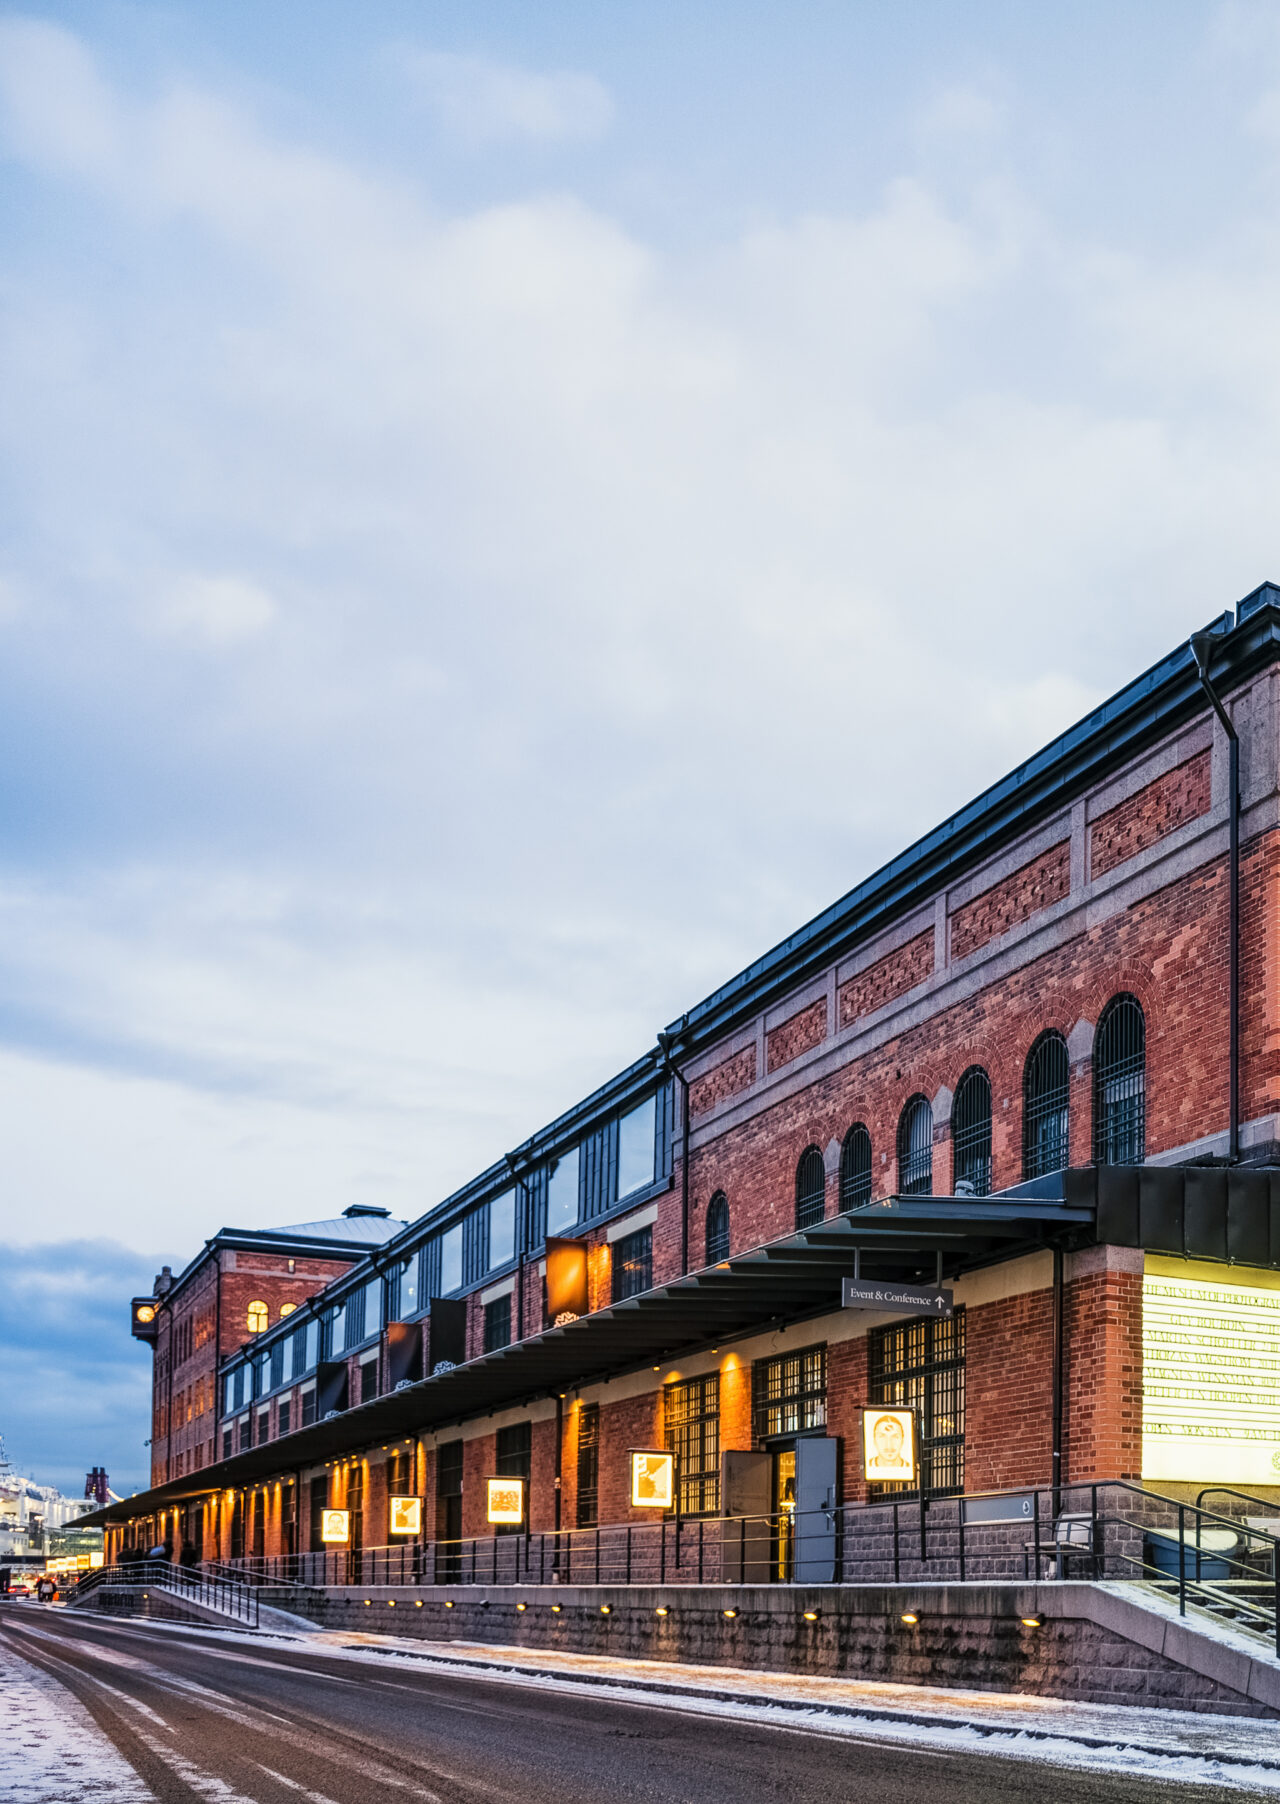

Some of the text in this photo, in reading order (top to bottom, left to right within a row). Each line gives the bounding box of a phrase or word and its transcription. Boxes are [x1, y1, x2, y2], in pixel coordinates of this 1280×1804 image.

[850, 1288, 932, 1305] Event & Conference
